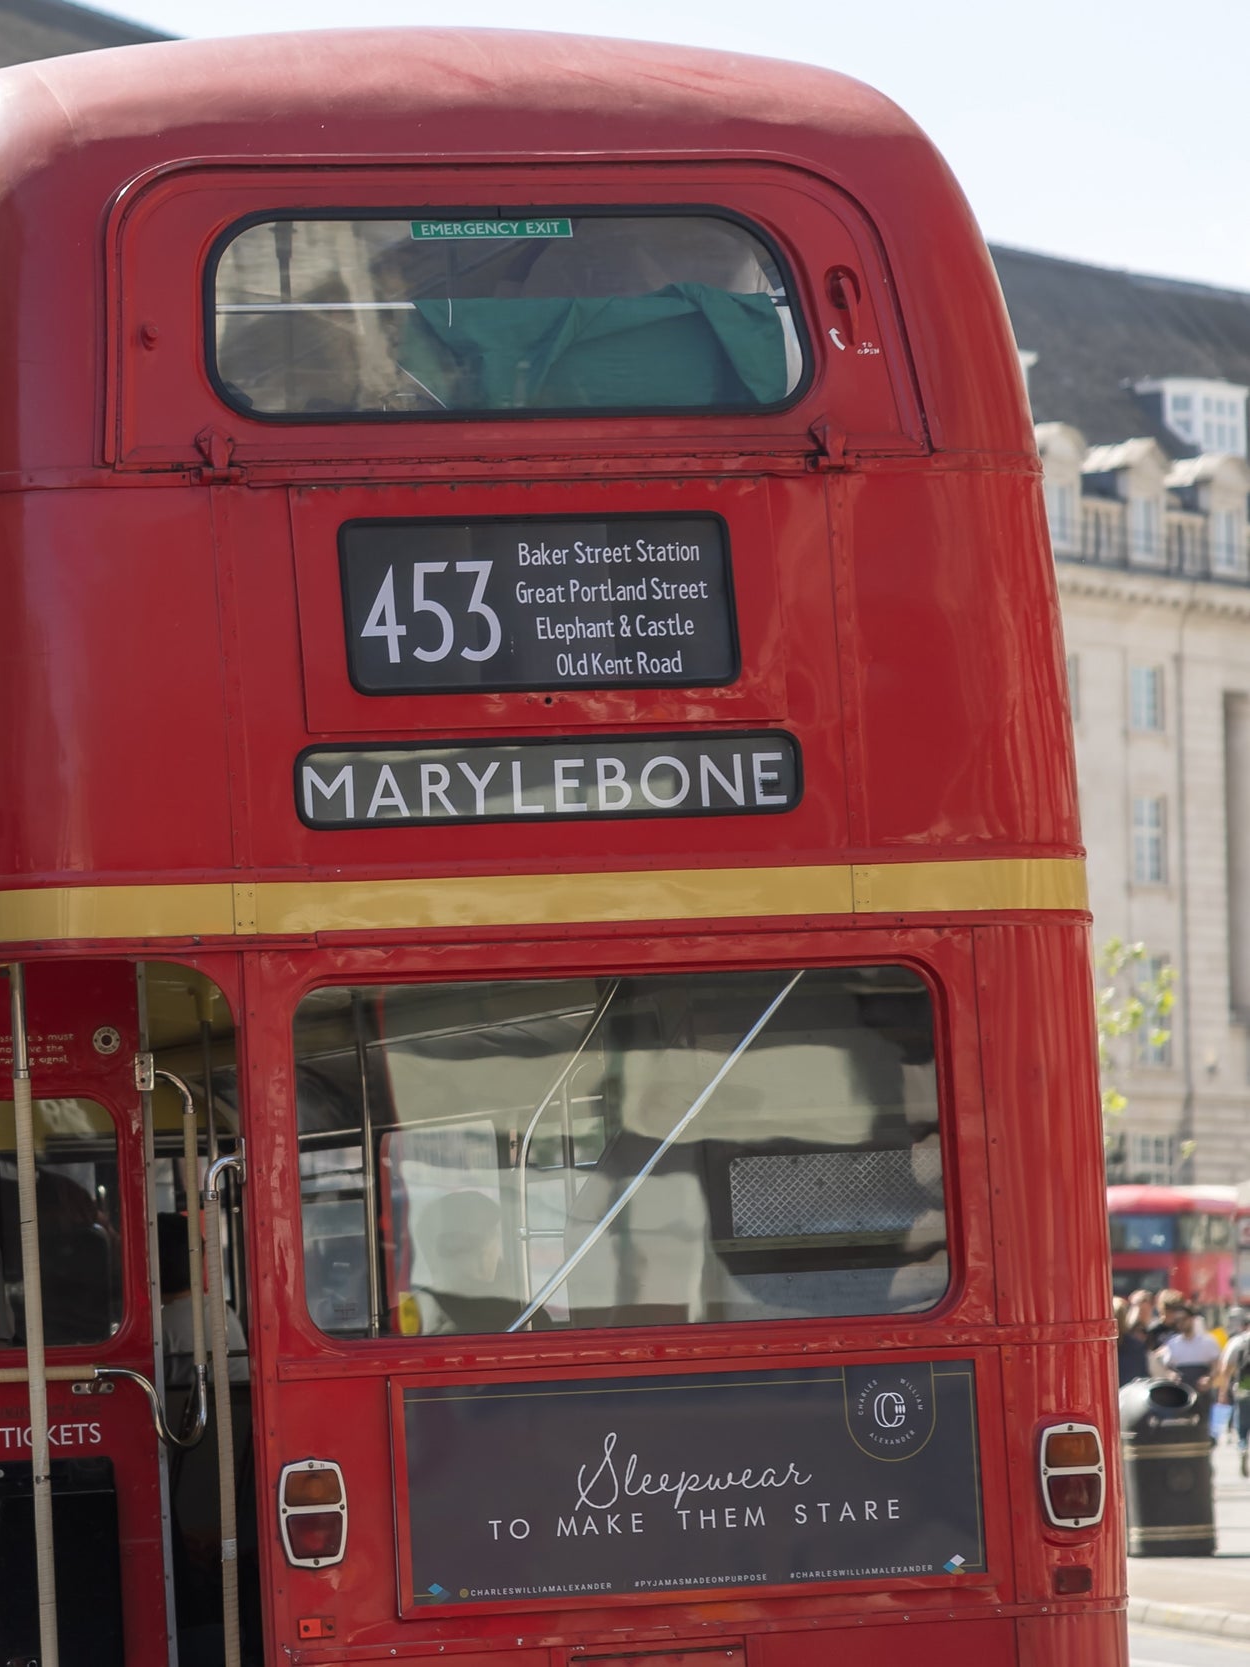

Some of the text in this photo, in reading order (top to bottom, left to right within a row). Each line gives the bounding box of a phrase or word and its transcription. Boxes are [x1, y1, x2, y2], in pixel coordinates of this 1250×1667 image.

[421, 222, 560, 236] EMERGENCY EXIT
[518, 539, 700, 566] Baker Street Station
[516, 577, 708, 604] Great Portland Street
[360, 560, 502, 663] 453
[536, 613, 694, 645] Elephant & Castle
[556, 650, 683, 677] Old Kent Road
[302, 751, 789, 820] MARYLEBONE
[46, 1044, 64, 1052] the
[48, 1033, 74, 1041] must
[39, 1055, 69, 1065] signal
[858, 1379, 878, 1416] CHARLES
[900, 1378, 923, 1411] WILLIAM
[869, 1429, 915, 1445] ALEXANDER
[575, 1431, 813, 1512] Sleepwear
[488, 1498, 901, 1541] TO MAKE THEM STARE
[634, 1573, 768, 1588] #PYJAMASMADEONPURPOSE
[790, 1564, 934, 1579] #CHARLESWILLIAMALEXANDER
